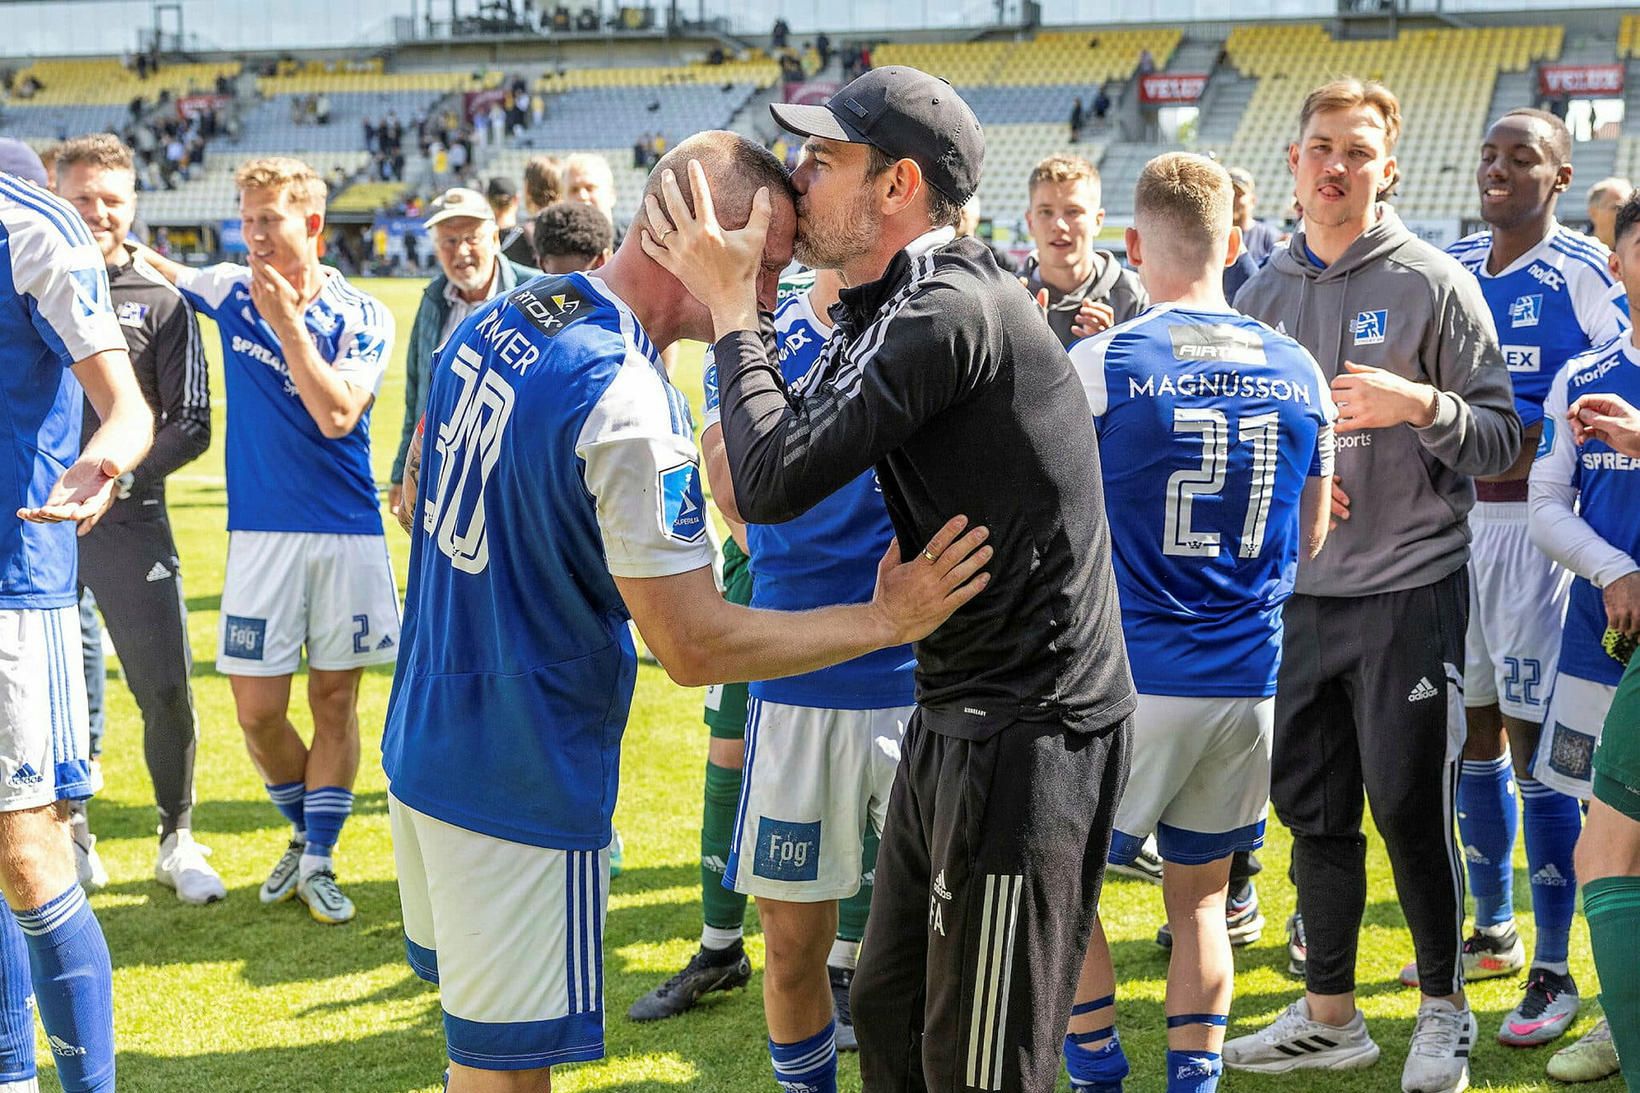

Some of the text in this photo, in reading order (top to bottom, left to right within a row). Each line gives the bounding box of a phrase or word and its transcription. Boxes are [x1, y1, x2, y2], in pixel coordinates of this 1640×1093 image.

[514, 290, 560, 329] RTOX
[1506, 351, 1534, 366] EX
[1128, 370, 1312, 406] MAGNÚSSON
[1582, 452, 1640, 471] SPREA
[1162, 407, 1279, 559] 21
[352, 614, 370, 653] 2
[1408, 687, 1439, 702] adidas
[1504, 656, 1541, 706] 22
[929, 894, 946, 937] FA
